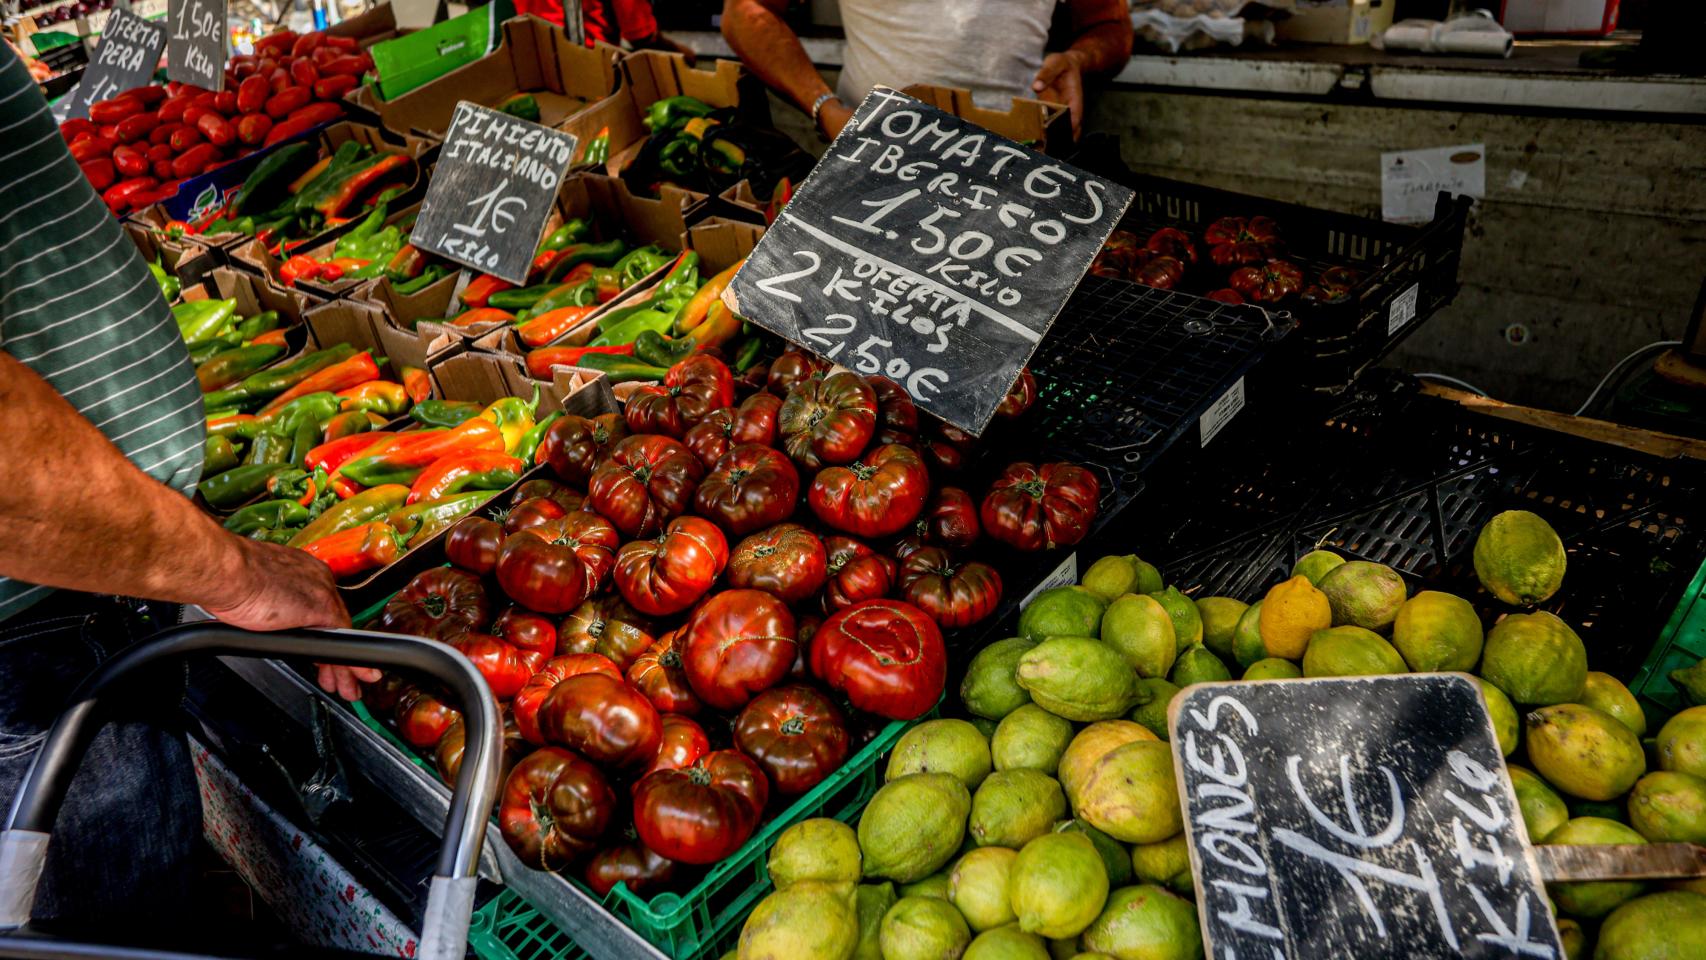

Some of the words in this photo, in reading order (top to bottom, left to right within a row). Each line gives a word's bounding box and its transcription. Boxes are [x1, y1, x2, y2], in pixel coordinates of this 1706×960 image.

[101, 8, 161, 50] OFERTA
[173, 0, 221, 42] 1.50€
[98, 39, 146, 72] PERA
[184, 44, 214, 79] KILO
[446, 104, 570, 165] PIMIENTO
[446, 138, 557, 190] ITALIANO
[856, 90, 1106, 225] TOMATES
[453, 177, 527, 237] 1€
[837, 137, 1067, 245] IBERICO
[437, 233, 500, 268] KILO
[832, 188, 1043, 278] 1.50€
[756, 250, 821, 303] 2
[822, 268, 954, 353] KILOS
[853, 258, 973, 327] OFERTA
[927, 257, 1022, 307] KILO
[802, 313, 949, 402] 2,50€
[1271, 754, 1460, 952] 1€
